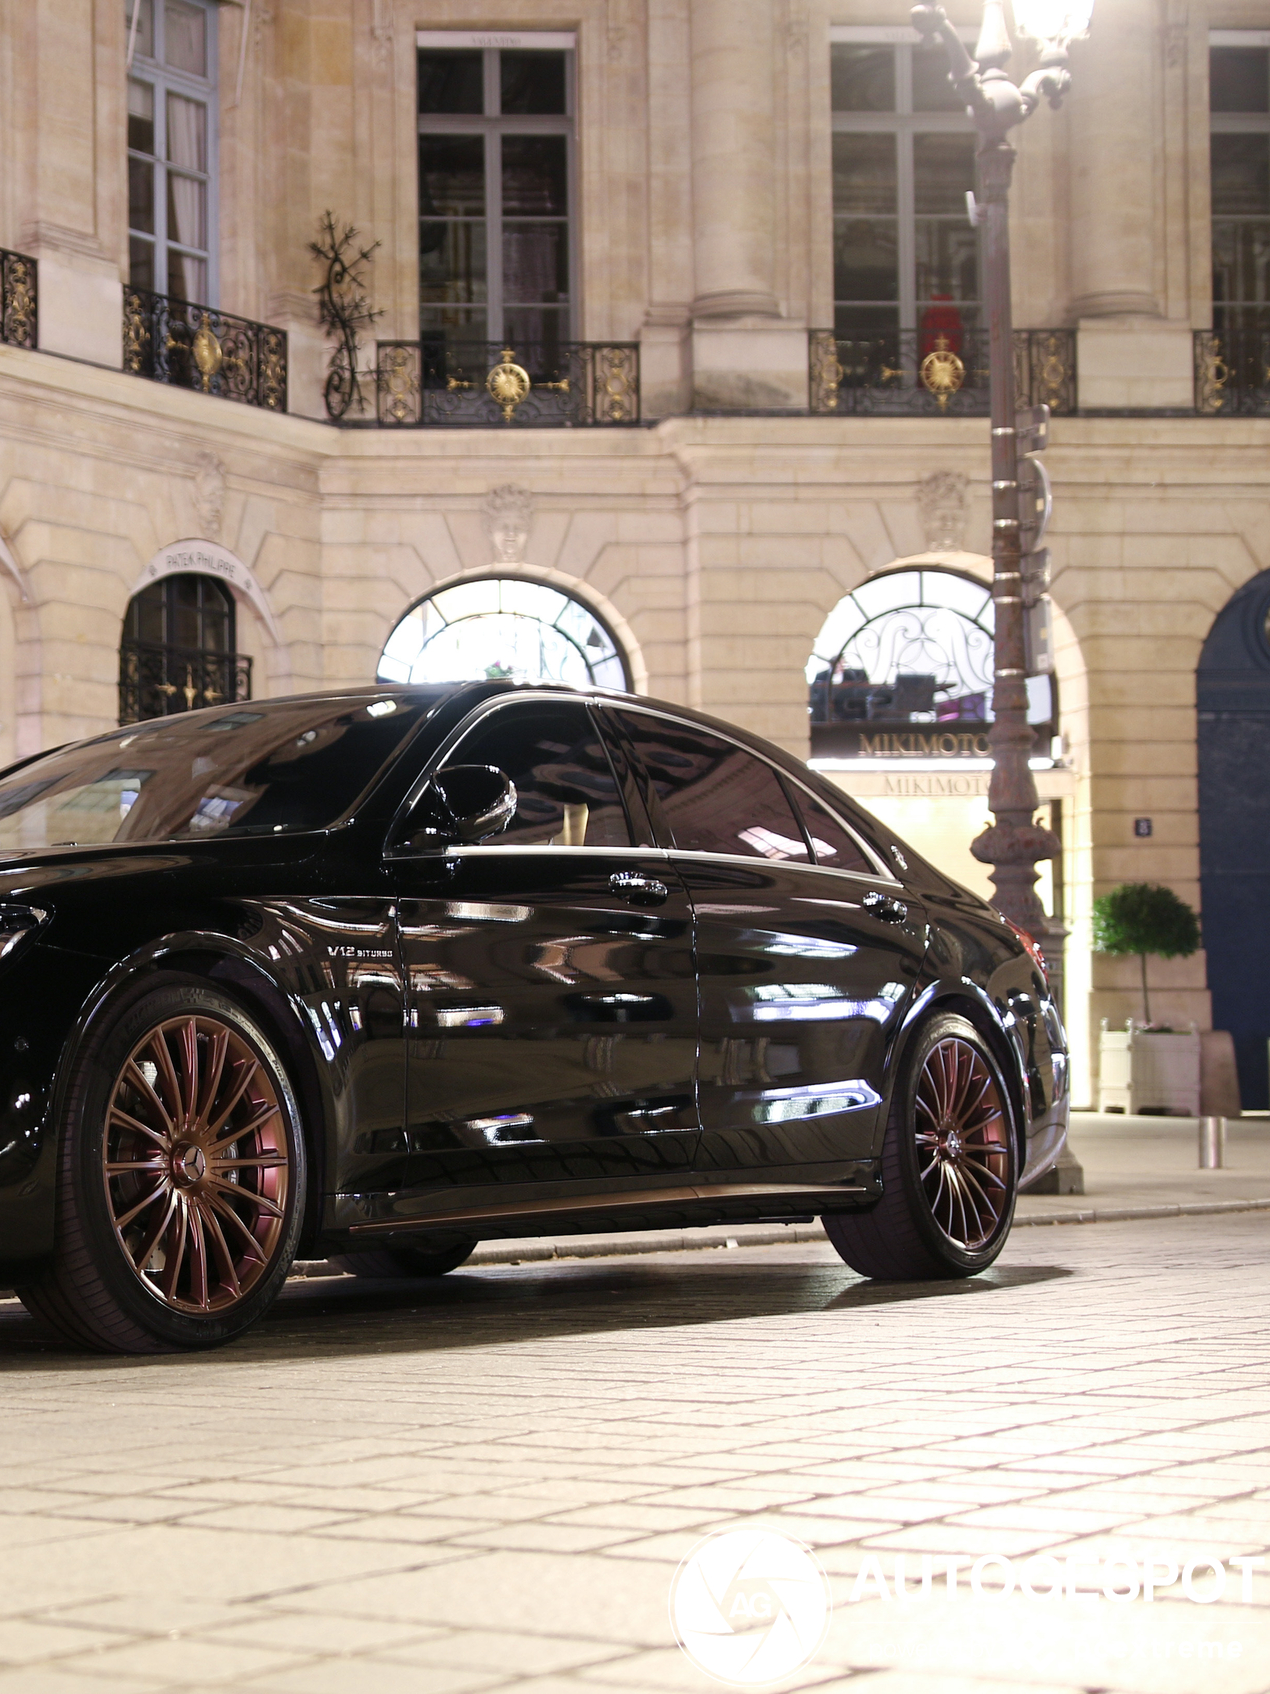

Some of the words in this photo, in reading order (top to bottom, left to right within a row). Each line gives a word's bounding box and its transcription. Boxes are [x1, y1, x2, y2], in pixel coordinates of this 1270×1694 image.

[166, 552, 195, 569] PATEK
[857, 733, 993, 757] MIKIMOTO
[883, 775, 992, 795] MIKIMOT
[327, 945, 356, 957] V12
[356, 949, 393, 958] BITURBO
